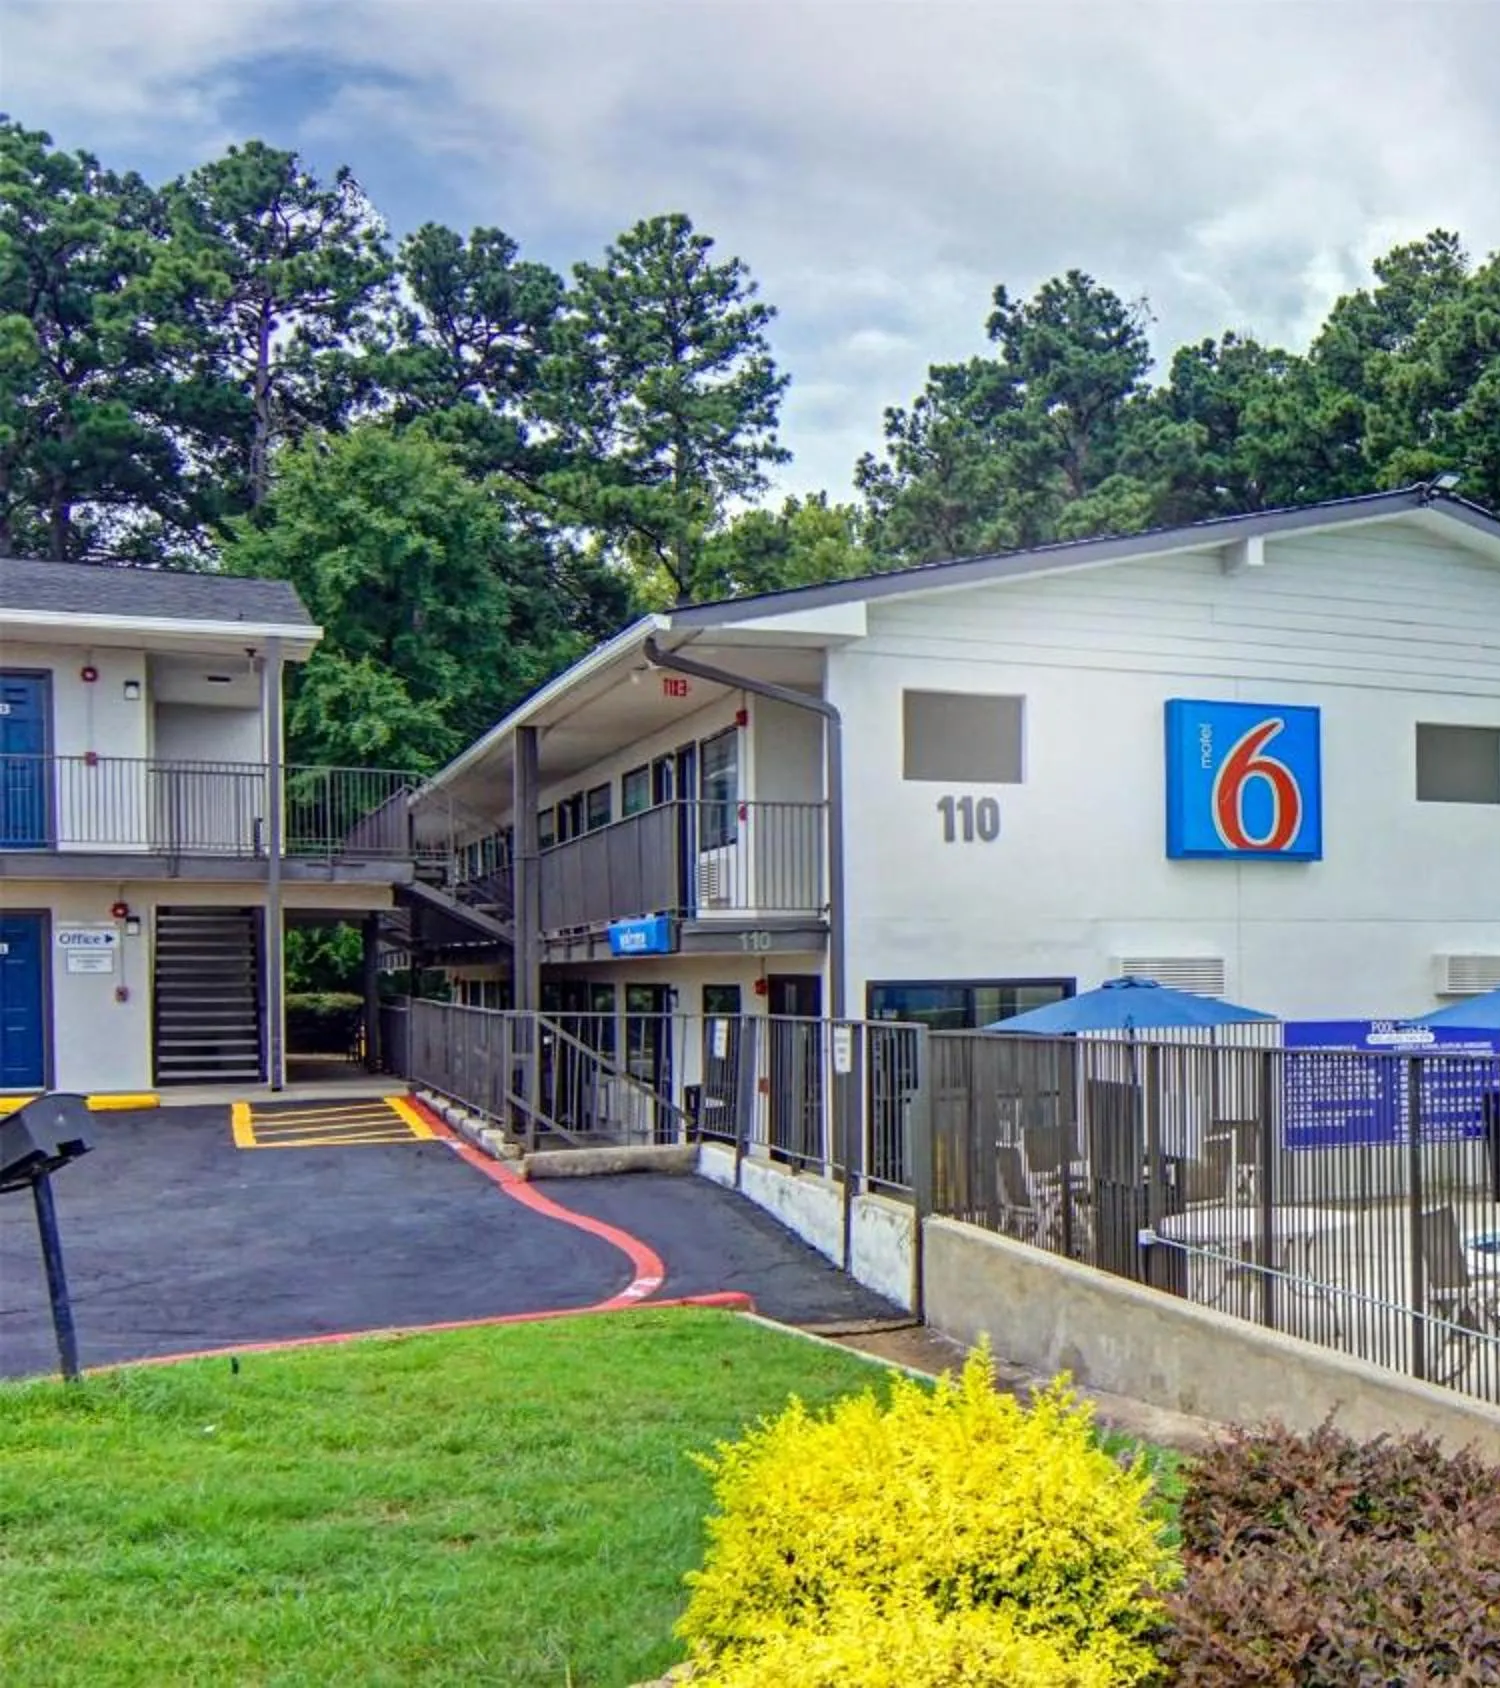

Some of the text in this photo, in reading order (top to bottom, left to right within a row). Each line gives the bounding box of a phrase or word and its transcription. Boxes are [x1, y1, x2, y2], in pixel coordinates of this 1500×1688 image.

[1198, 717, 1303, 851] motel 6
[936, 795, 1001, 843] 110
[58, 933, 101, 945] Office
[738, 931, 772, 951] 110
